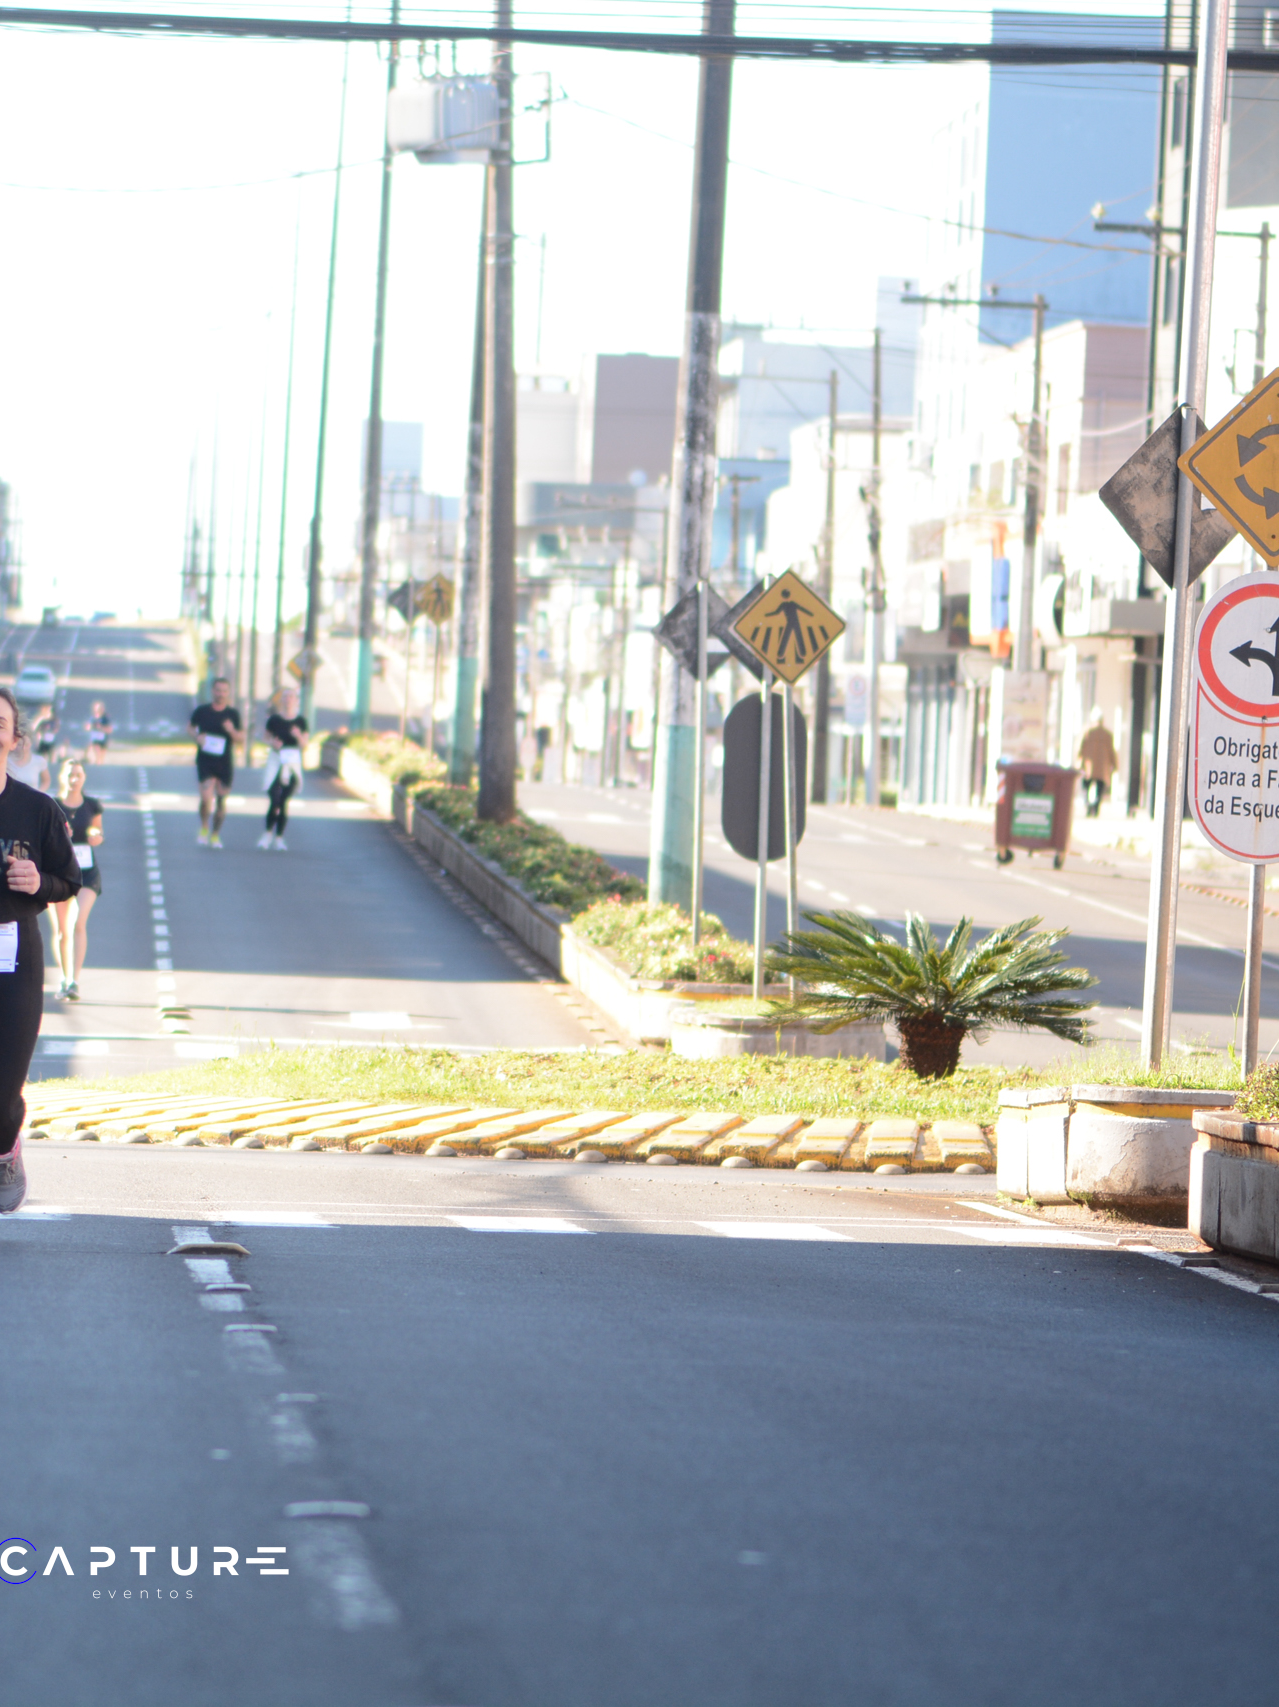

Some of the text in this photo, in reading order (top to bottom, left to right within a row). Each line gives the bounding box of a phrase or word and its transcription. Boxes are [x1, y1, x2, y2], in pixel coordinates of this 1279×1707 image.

[1214, 736, 1279, 763] Obrigat
[1208, 769, 1279, 789] para a F
[1204, 795, 1224, 815] da
